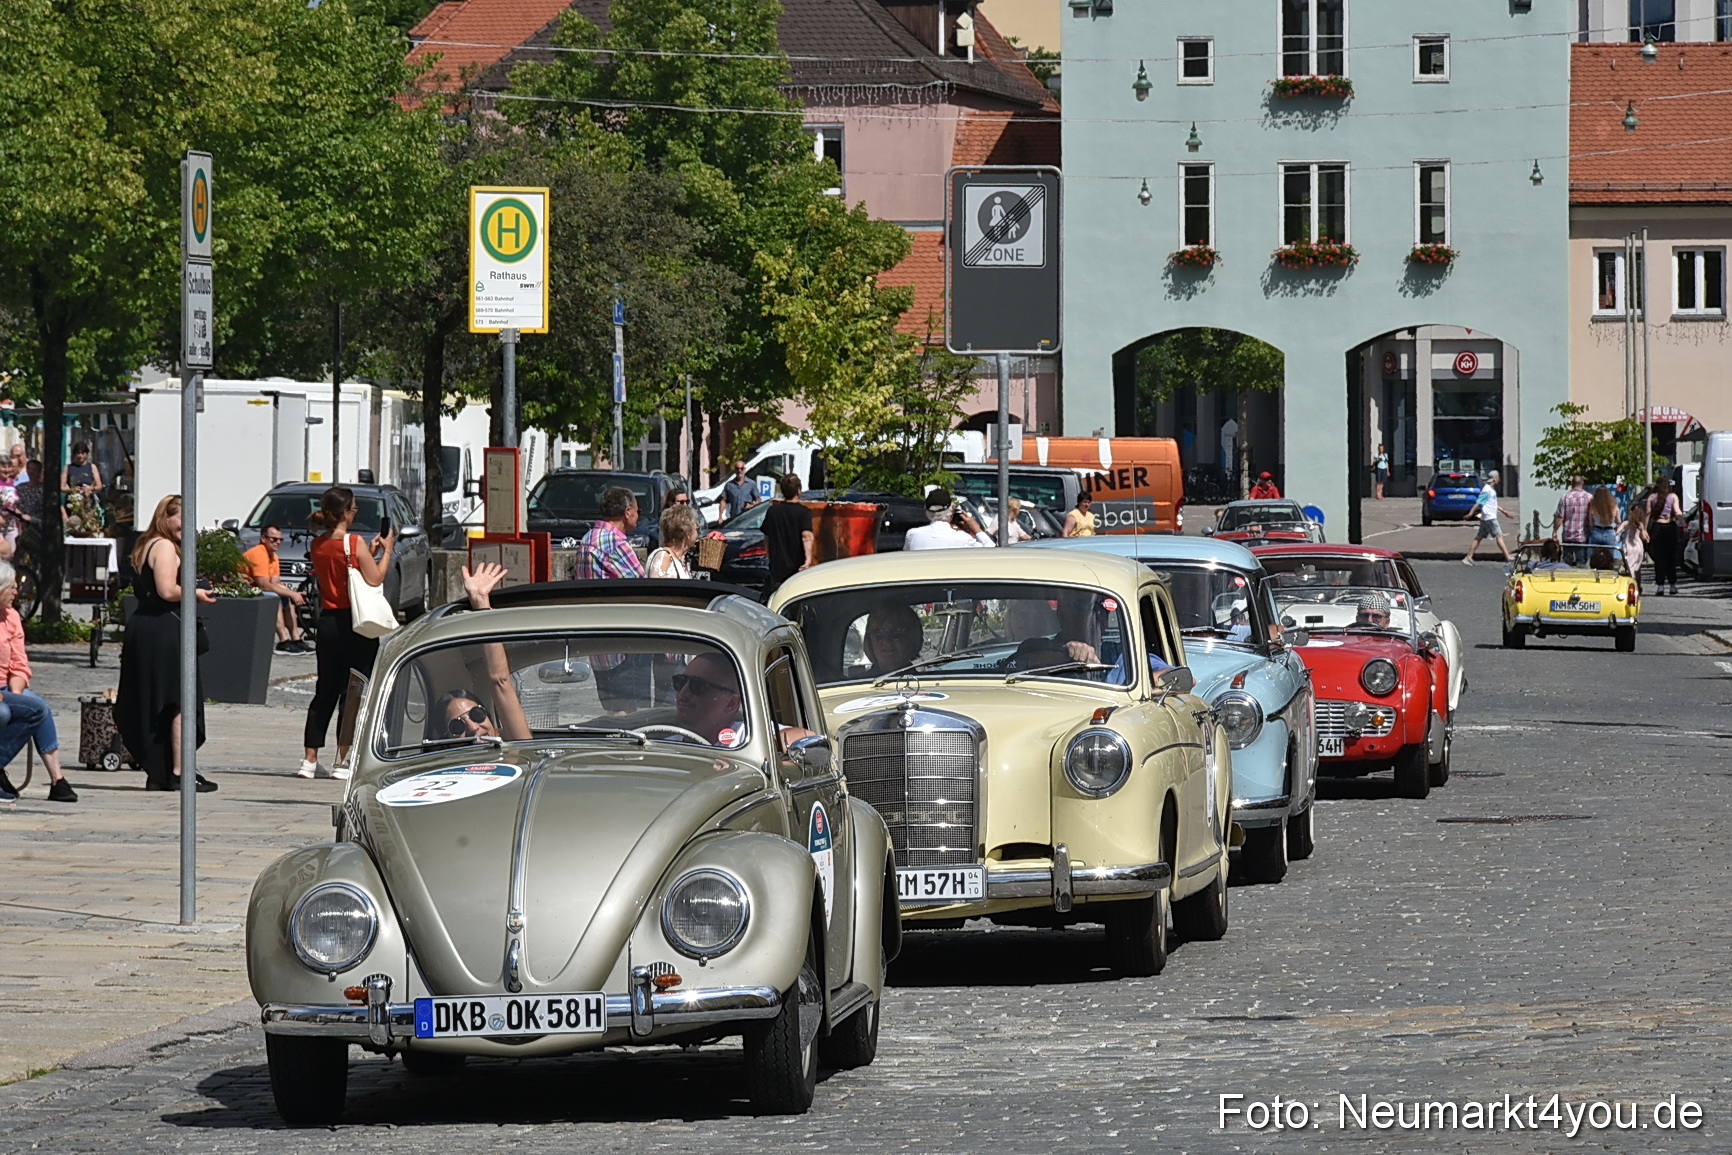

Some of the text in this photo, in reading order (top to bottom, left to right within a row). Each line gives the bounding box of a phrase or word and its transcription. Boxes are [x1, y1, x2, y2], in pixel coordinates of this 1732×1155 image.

[497, 212, 521, 249] H
[984, 248, 1025, 262] ZONE
[489, 271, 528, 281] Rathaus
[1460, 360, 1473, 369] KH
[762, 483, 770, 495] P
[924, 872, 966, 896] 57H
[968, 887, 979, 895] 10
[434, 1001, 486, 1033] DKB
